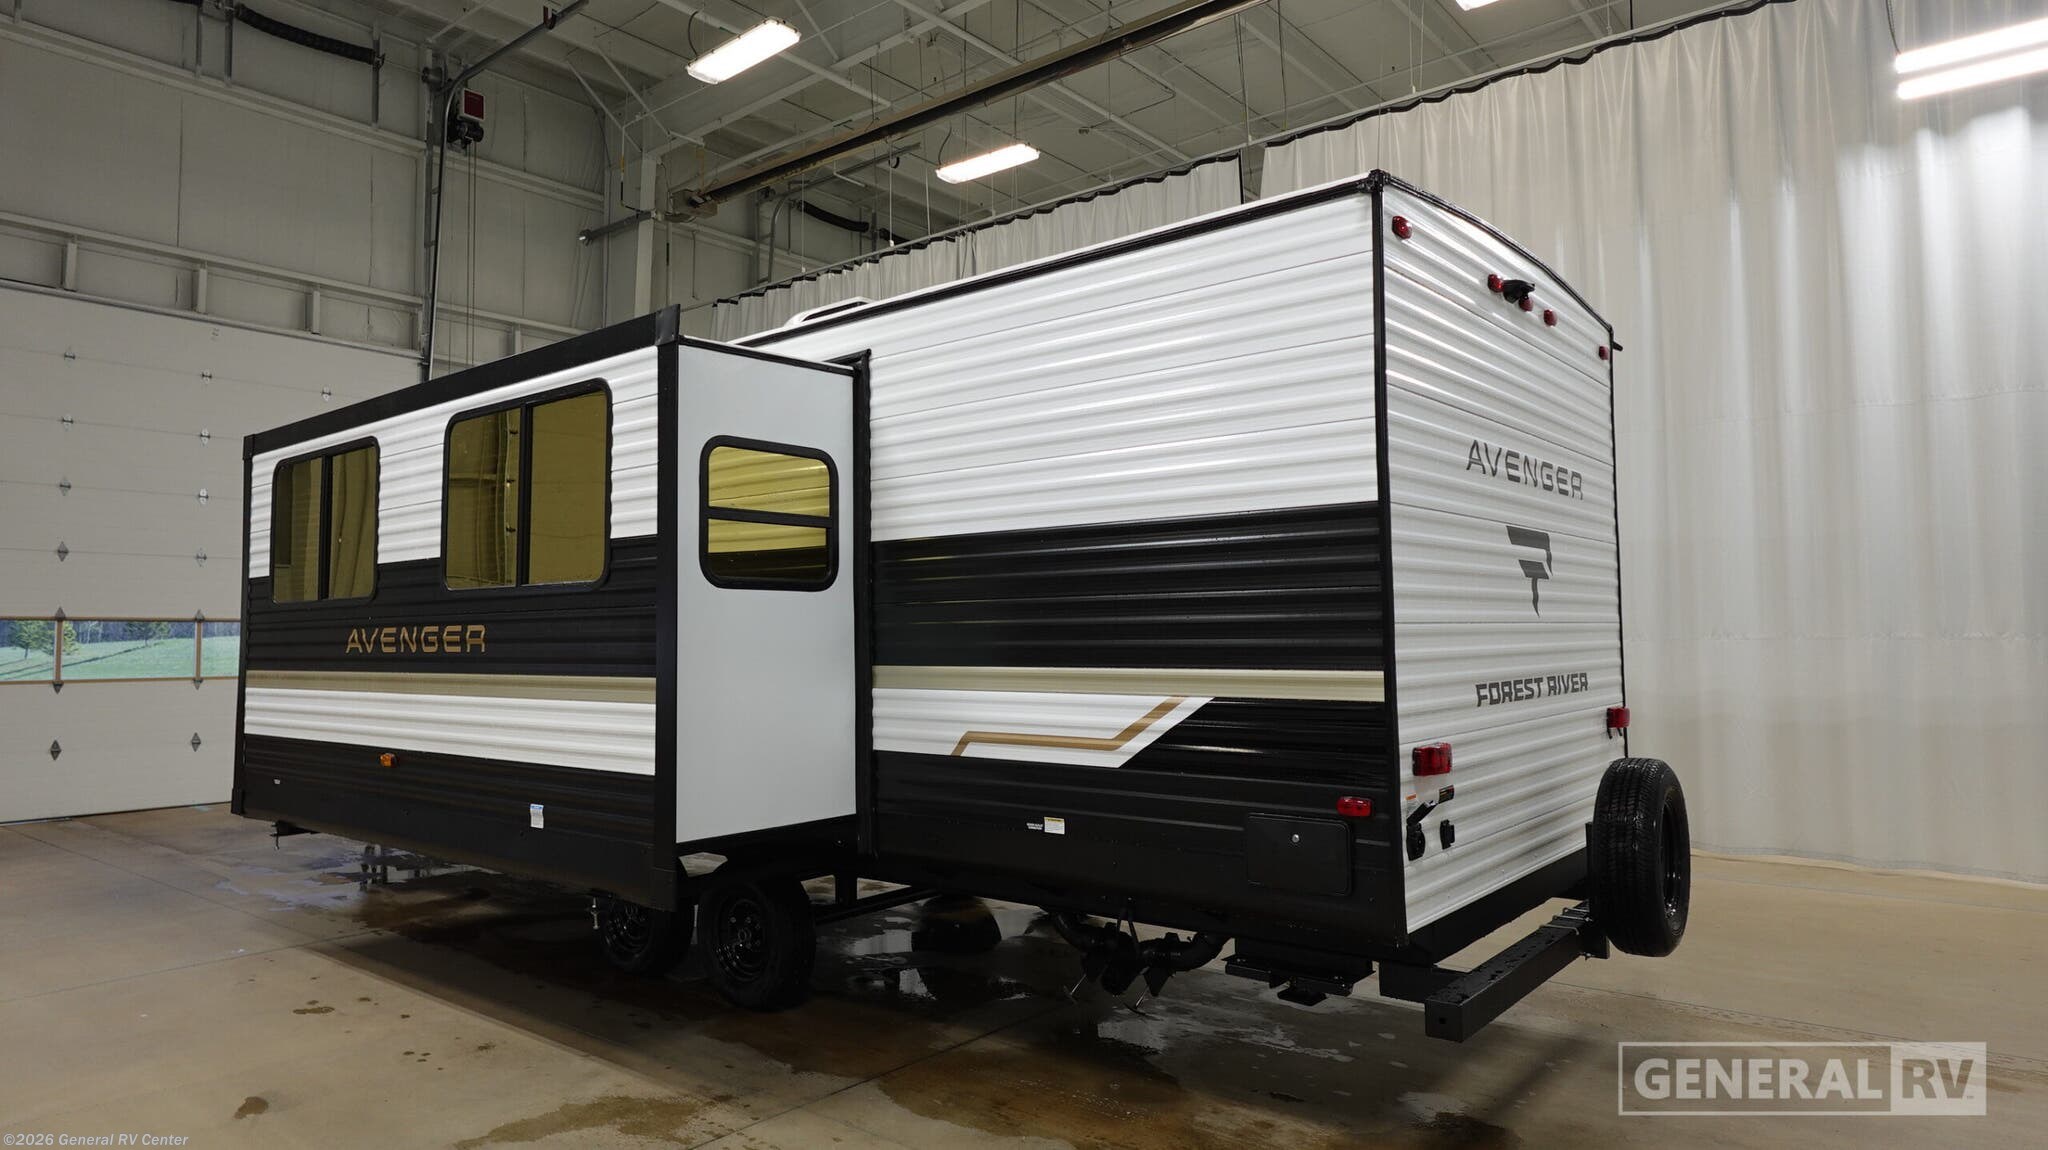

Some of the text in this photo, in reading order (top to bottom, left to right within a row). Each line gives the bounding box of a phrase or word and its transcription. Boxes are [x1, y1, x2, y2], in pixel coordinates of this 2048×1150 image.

[1466, 439, 1583, 501] AVENGER
[345, 624, 486, 654] AVENGER
[1475, 672, 1588, 708] FOREST RIVER
